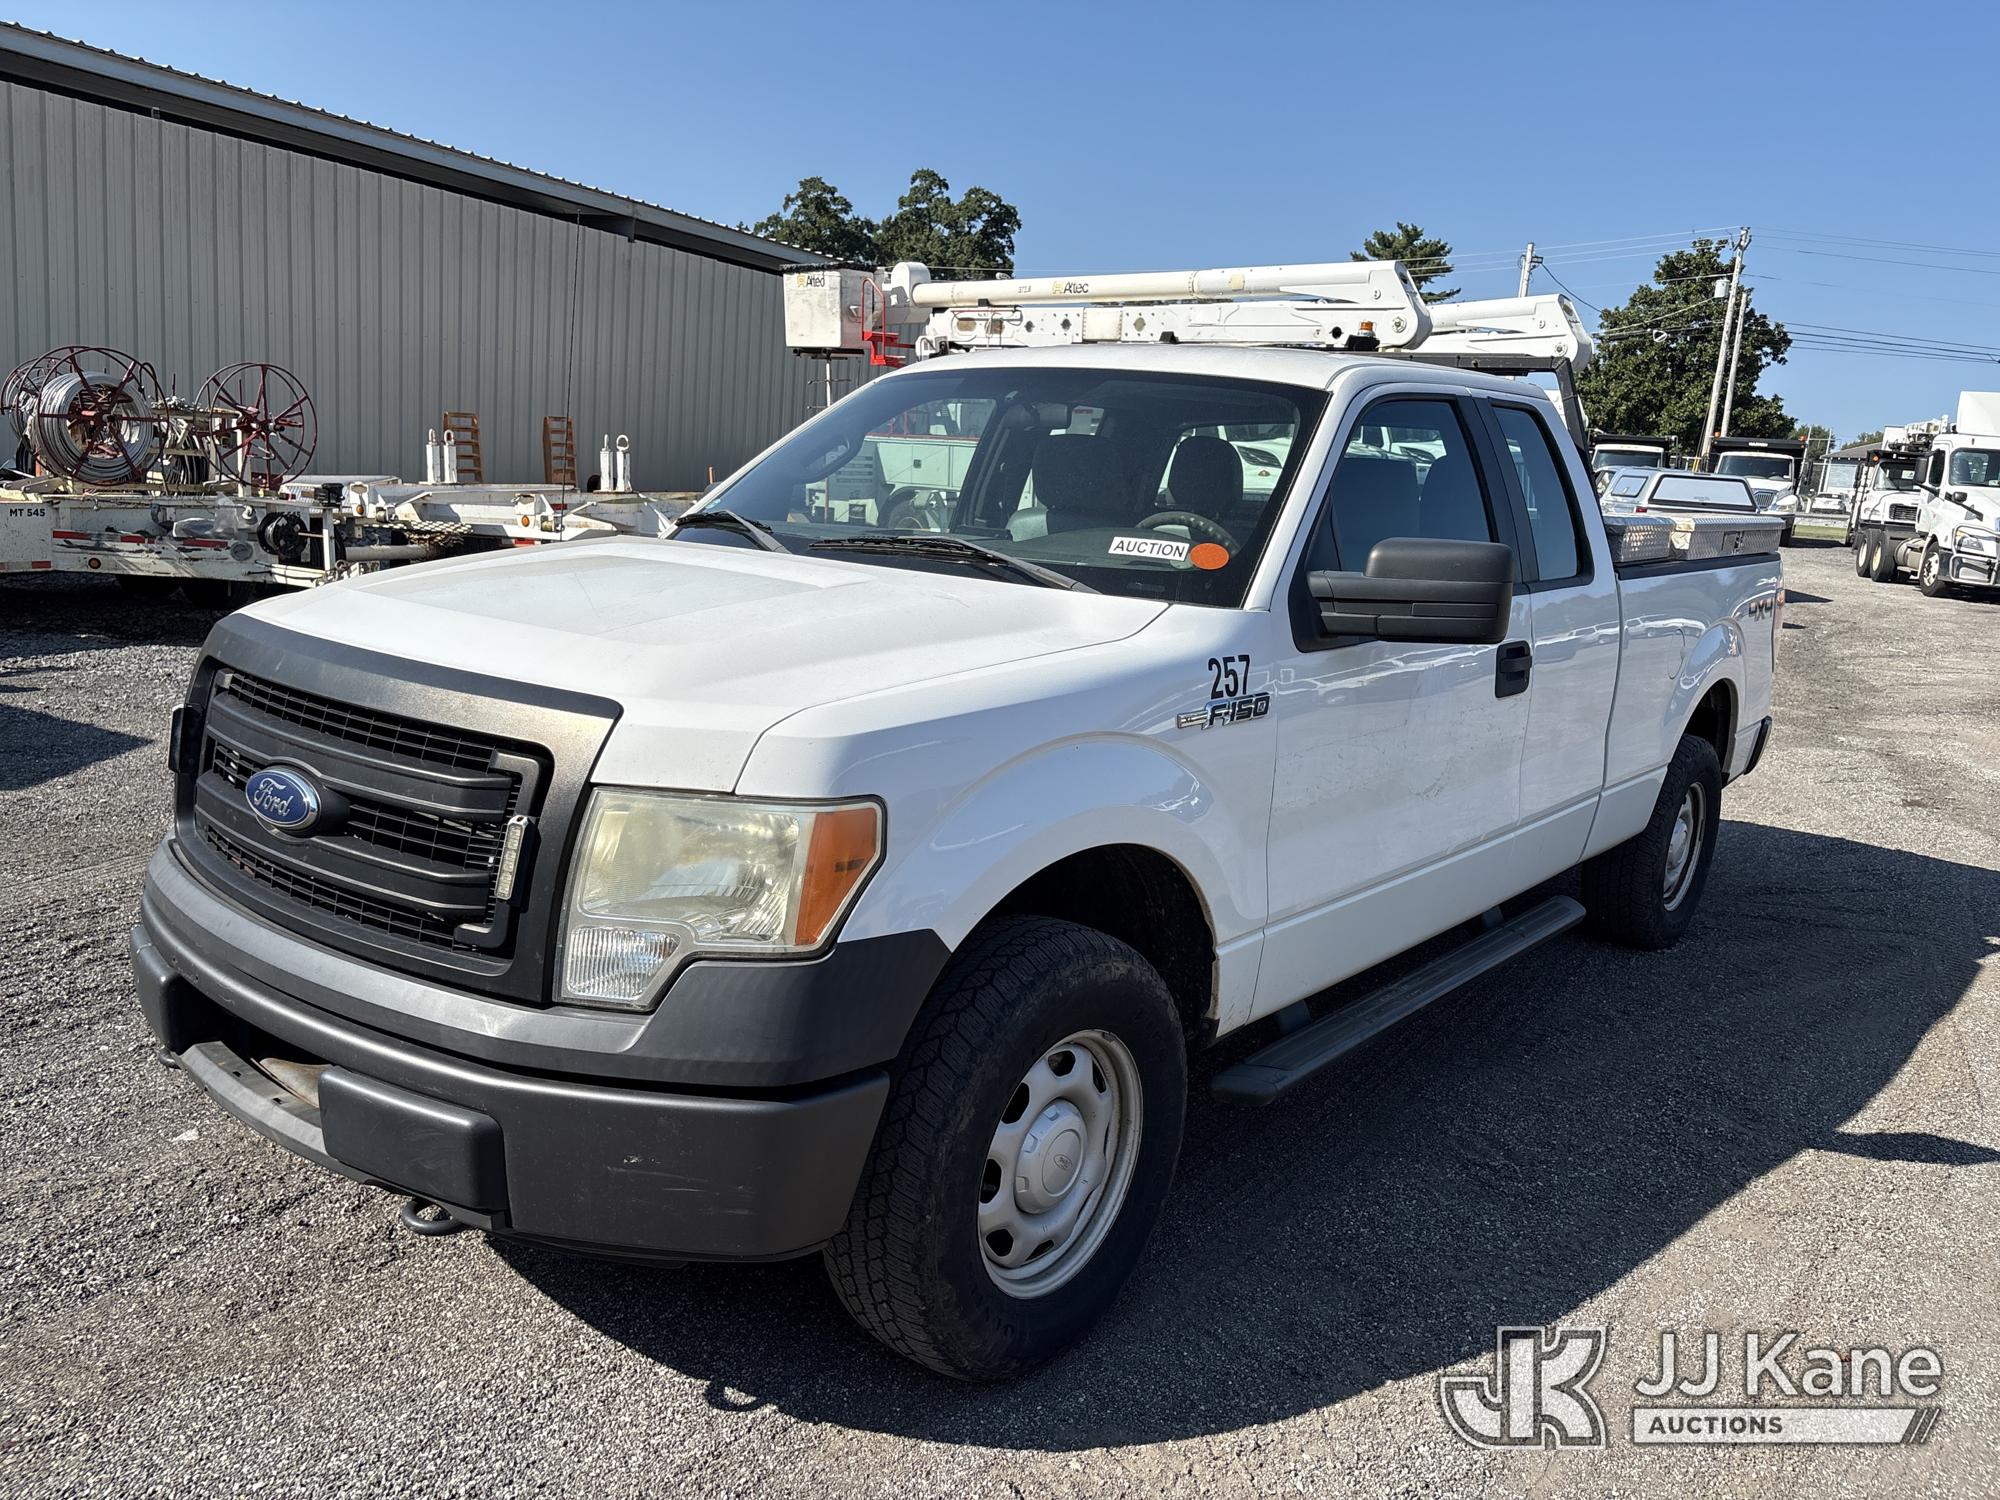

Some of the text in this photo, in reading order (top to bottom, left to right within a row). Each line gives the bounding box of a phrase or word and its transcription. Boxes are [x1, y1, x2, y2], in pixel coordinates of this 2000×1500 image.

[1063, 281, 1089, 294] Altec
[9, 508, 46, 517] MT 545
[1113, 540, 1186, 558] AUCTION
[1208, 654, 1251, 700] 257
[253, 777, 295, 817] Ford
